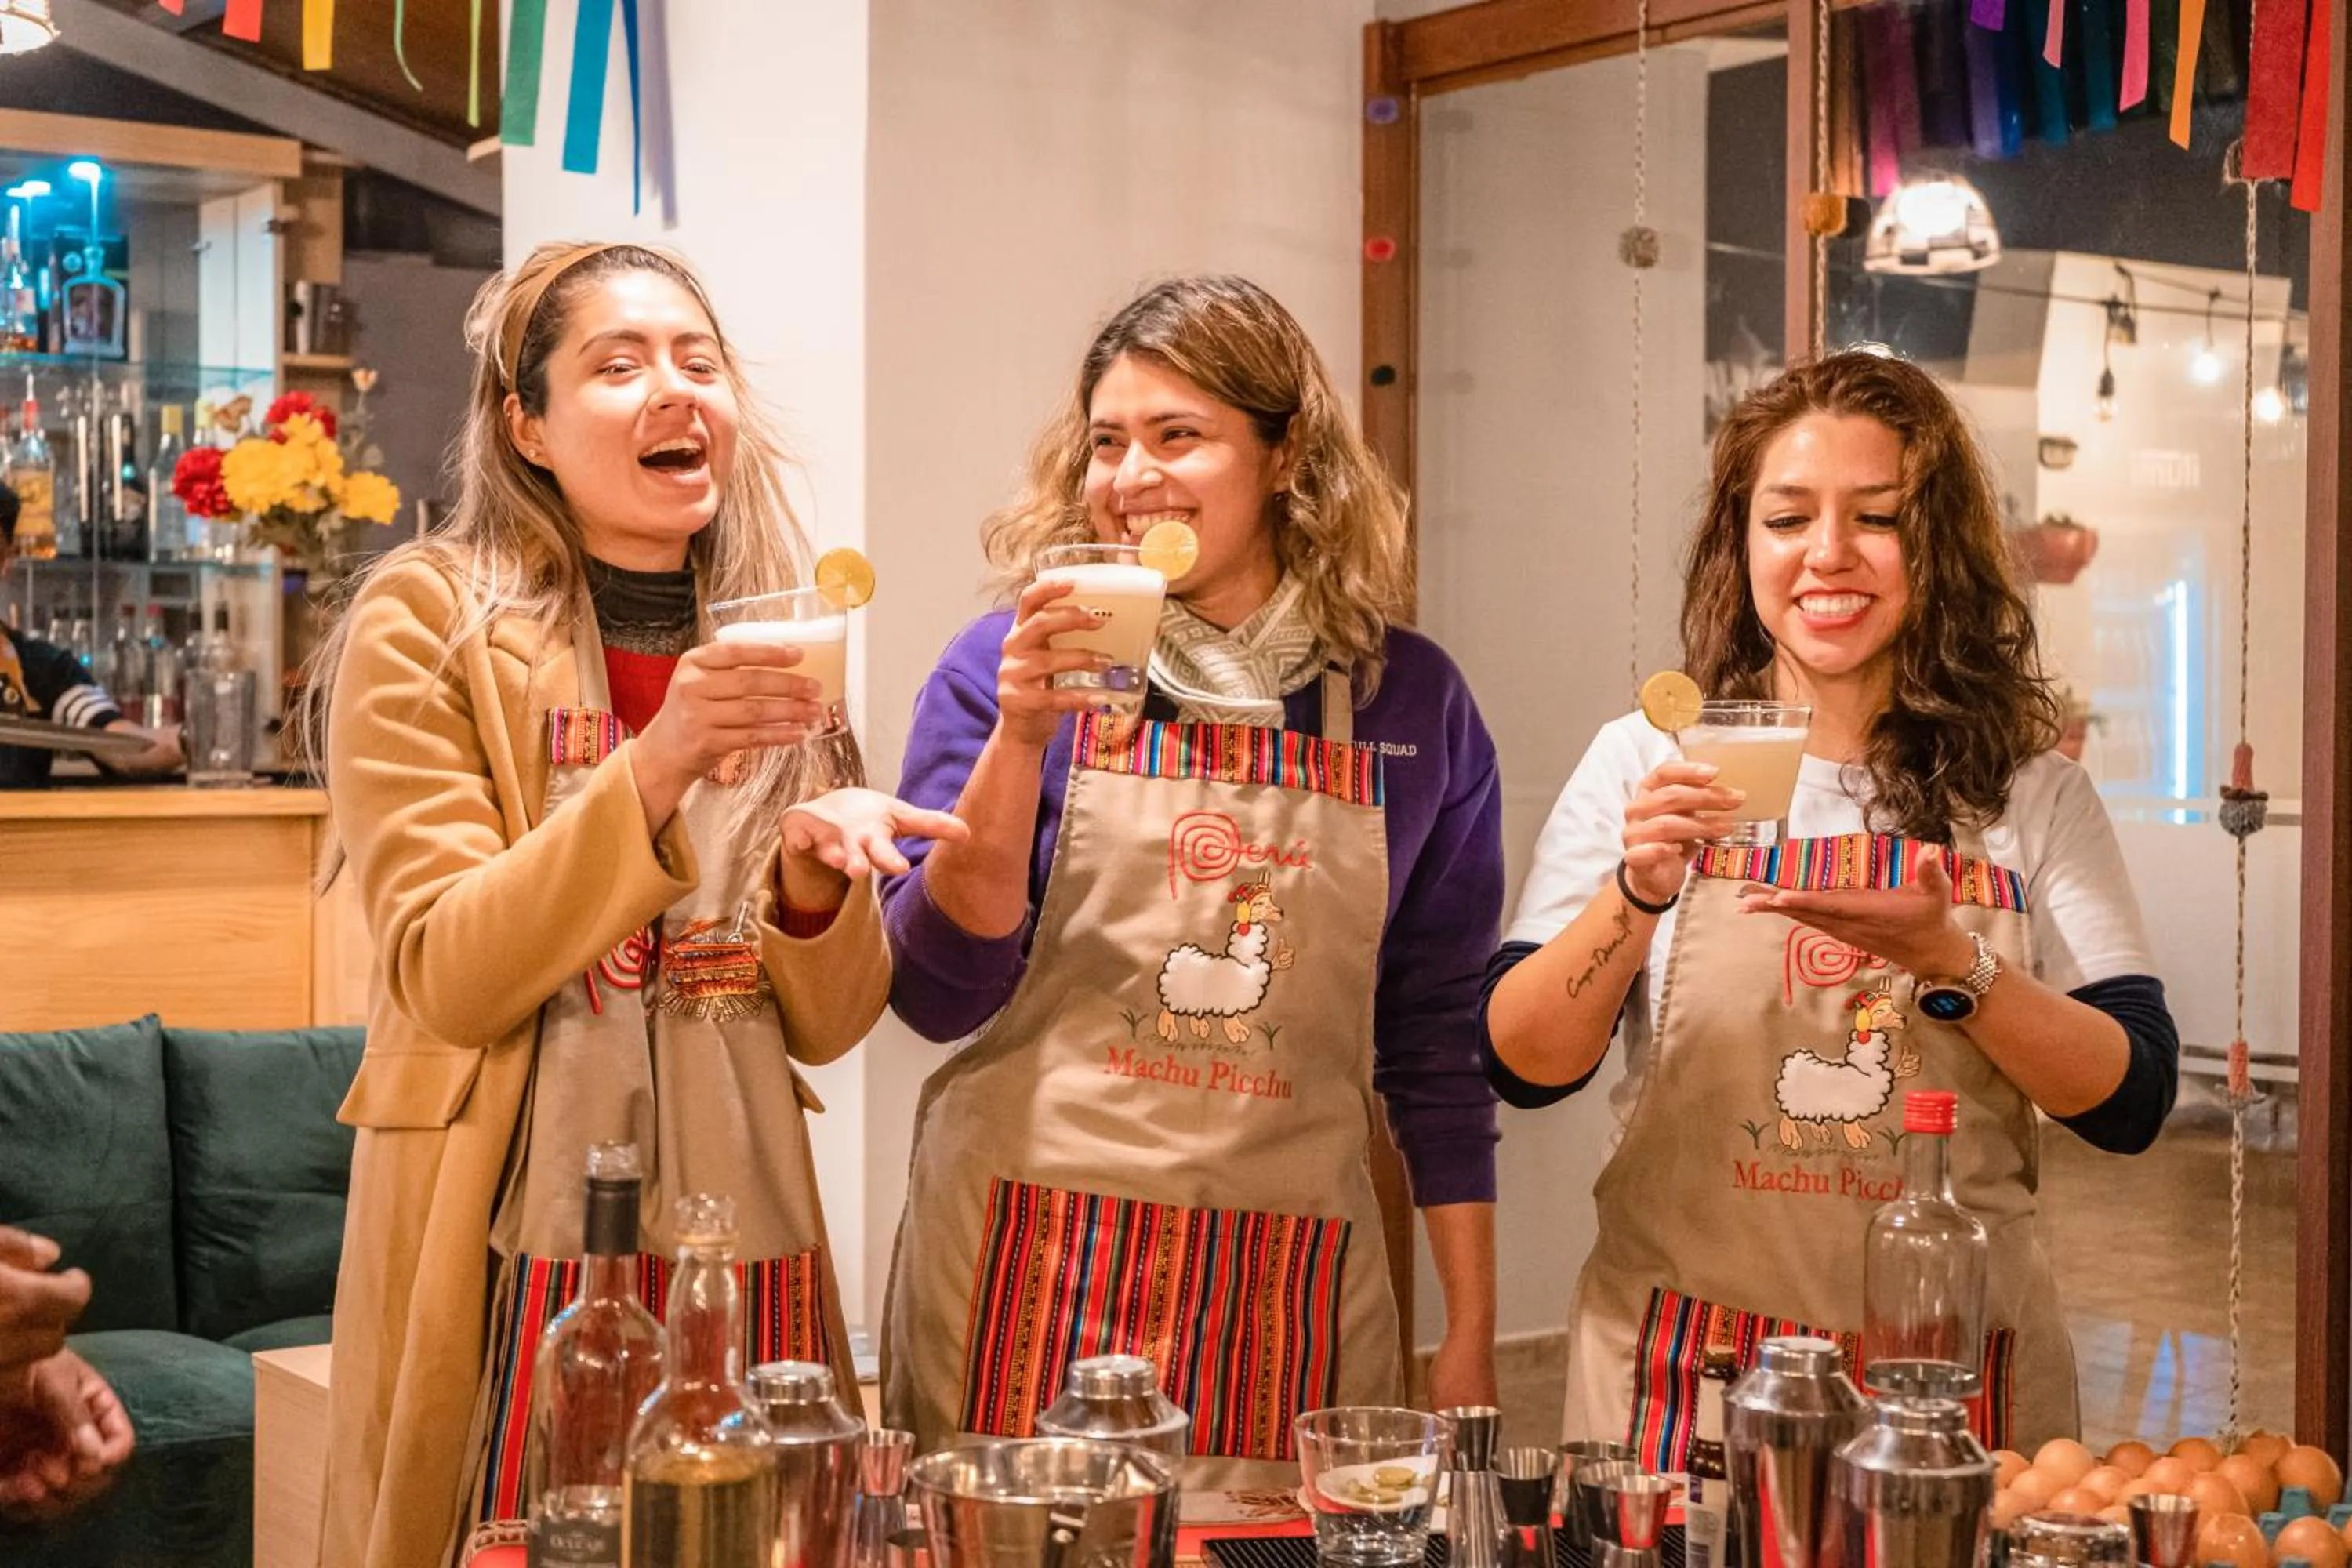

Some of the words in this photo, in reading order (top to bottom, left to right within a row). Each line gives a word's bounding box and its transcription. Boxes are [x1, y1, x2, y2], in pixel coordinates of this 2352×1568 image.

[1380, 742, 1417, 757] SQUAD
[1104, 1047, 1198, 1087] Machu
[1208, 1058, 1293, 1098] Picchu
[1733, 1160, 1829, 1193] Machu
[1840, 1167, 1904, 1202] Picc
